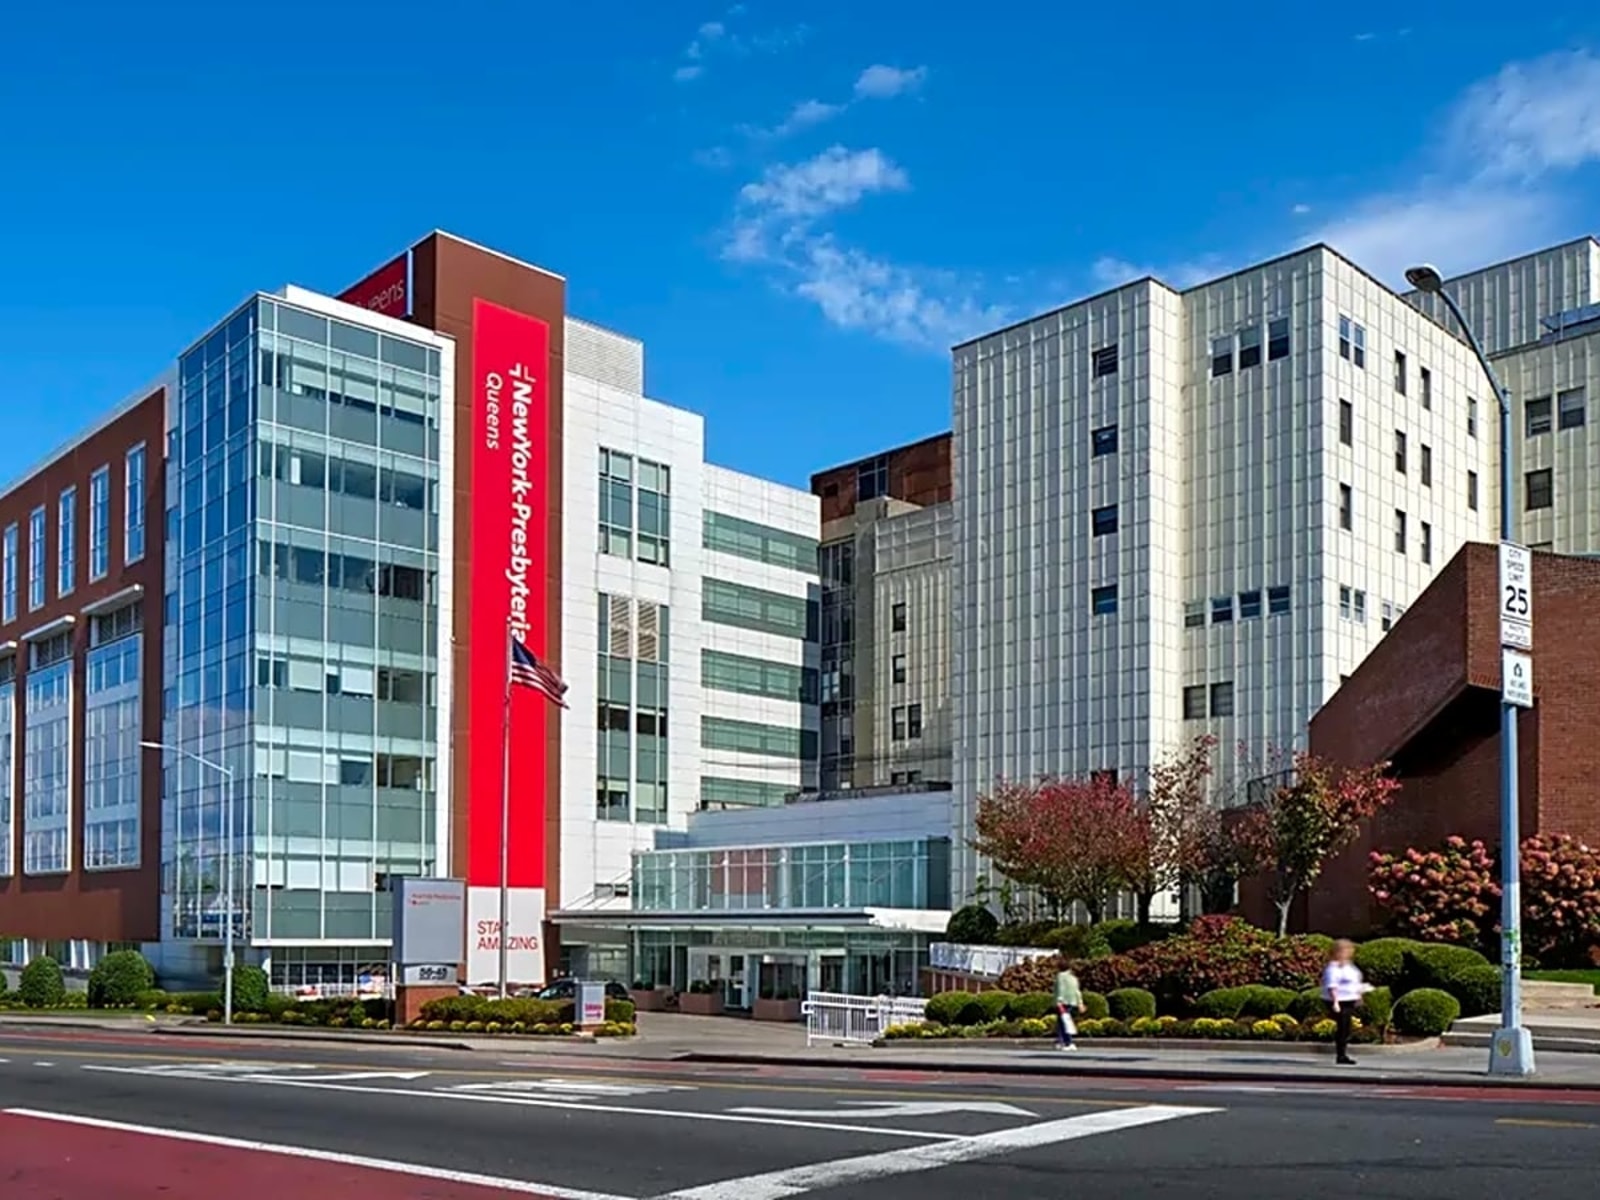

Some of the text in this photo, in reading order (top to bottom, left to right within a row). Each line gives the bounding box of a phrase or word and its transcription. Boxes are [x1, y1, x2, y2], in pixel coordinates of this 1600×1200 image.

[356, 279, 405, 310] eens
[485, 372, 503, 449] Queens
[505, 381, 534, 645] NewYork-Presbyteria
[1505, 585, 1529, 616] 25
[477, 920, 509, 935] STA
[477, 936, 539, 950] AMZING
